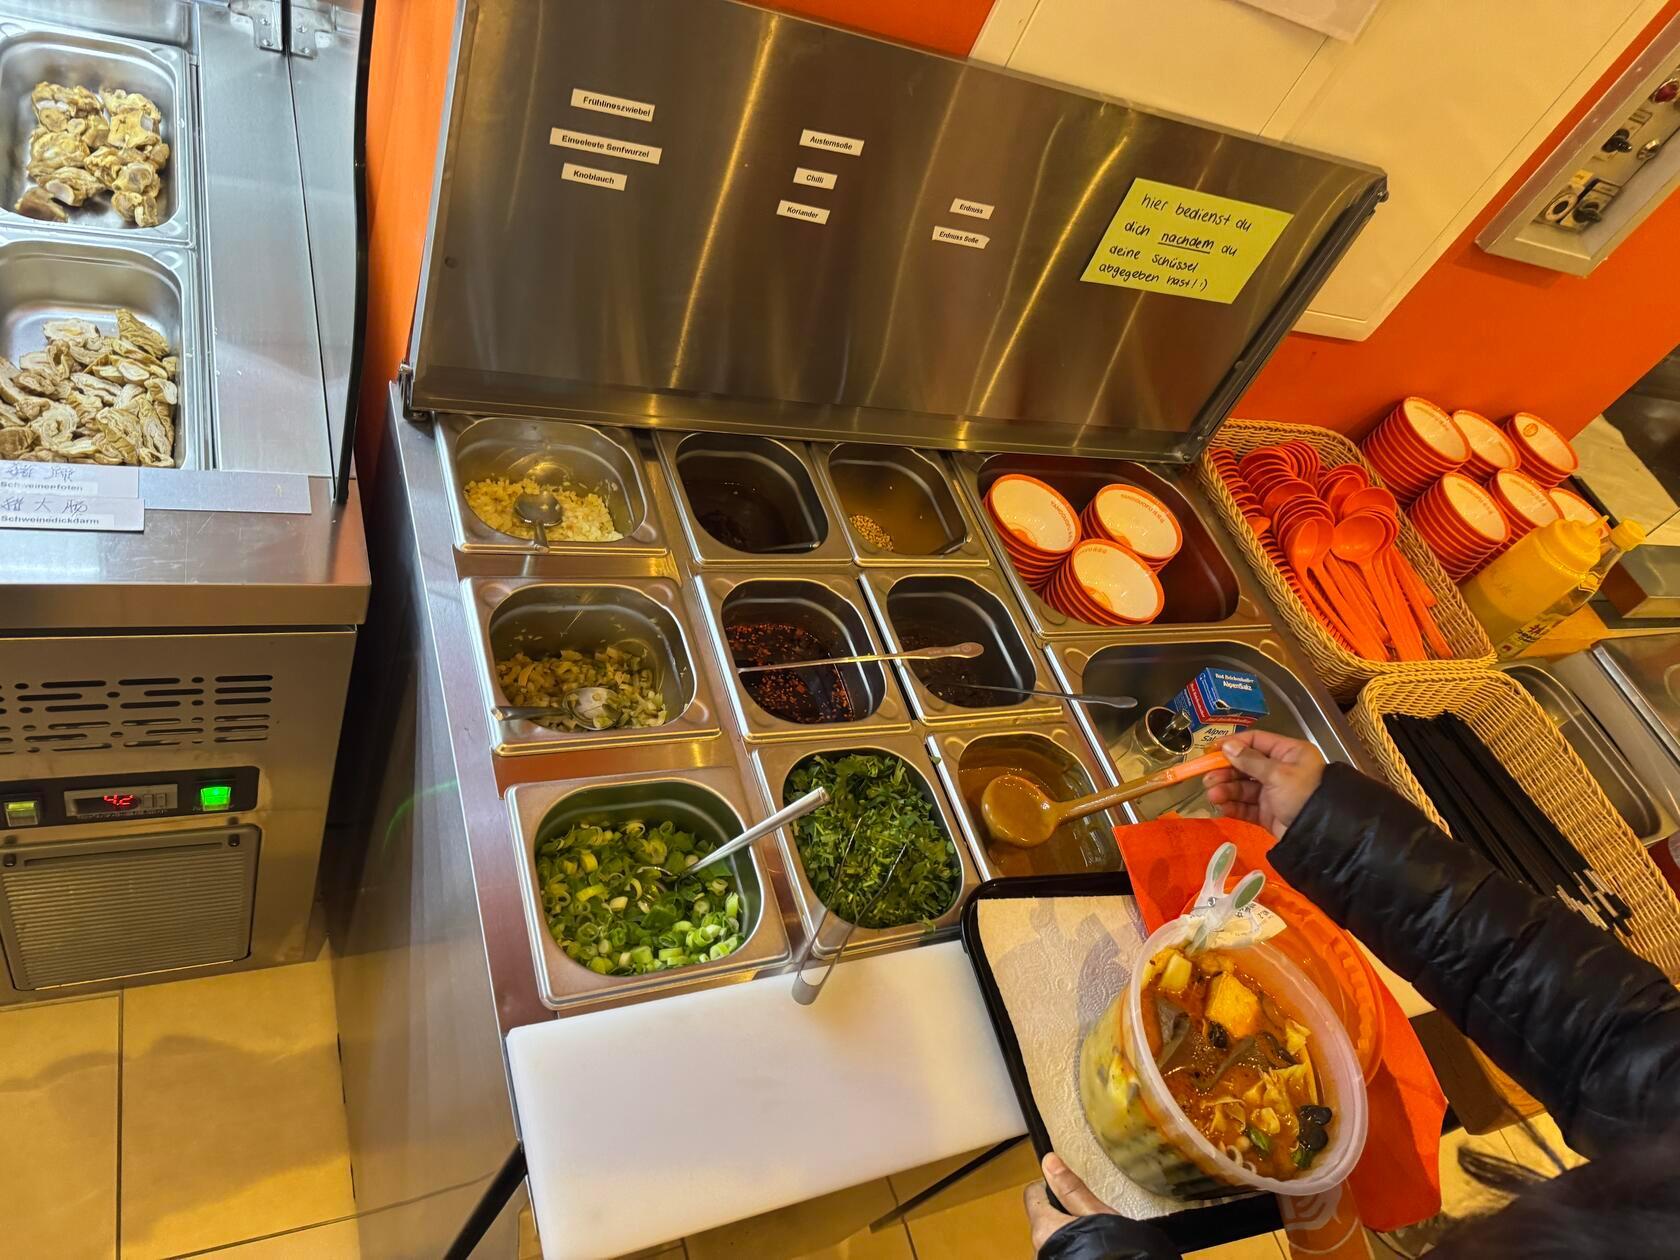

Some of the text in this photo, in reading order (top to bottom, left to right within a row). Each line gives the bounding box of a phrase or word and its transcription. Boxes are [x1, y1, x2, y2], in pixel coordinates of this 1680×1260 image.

[583, 96, 651, 117] Frühlingszwiebel
[606, 143, 650, 158] Senfwurzel
[809, 135, 853, 151] Austernsoße
[573, 169, 615, 185] Knoblauch
[806, 174, 824, 184] Chilli
[786, 206, 819, 219] Koriander
[959, 203, 984, 215] Erdnuss
[1141, 193, 1253, 233] hier bedienst du
[939, 230, 963, 242] Erdnuss
[1124, 220, 1238, 257] dich nachdem du
[1109, 244, 1141, 260] deine
[1098, 263, 1160, 283] abgegeben
[1205, 728, 1230, 736] Alpen
